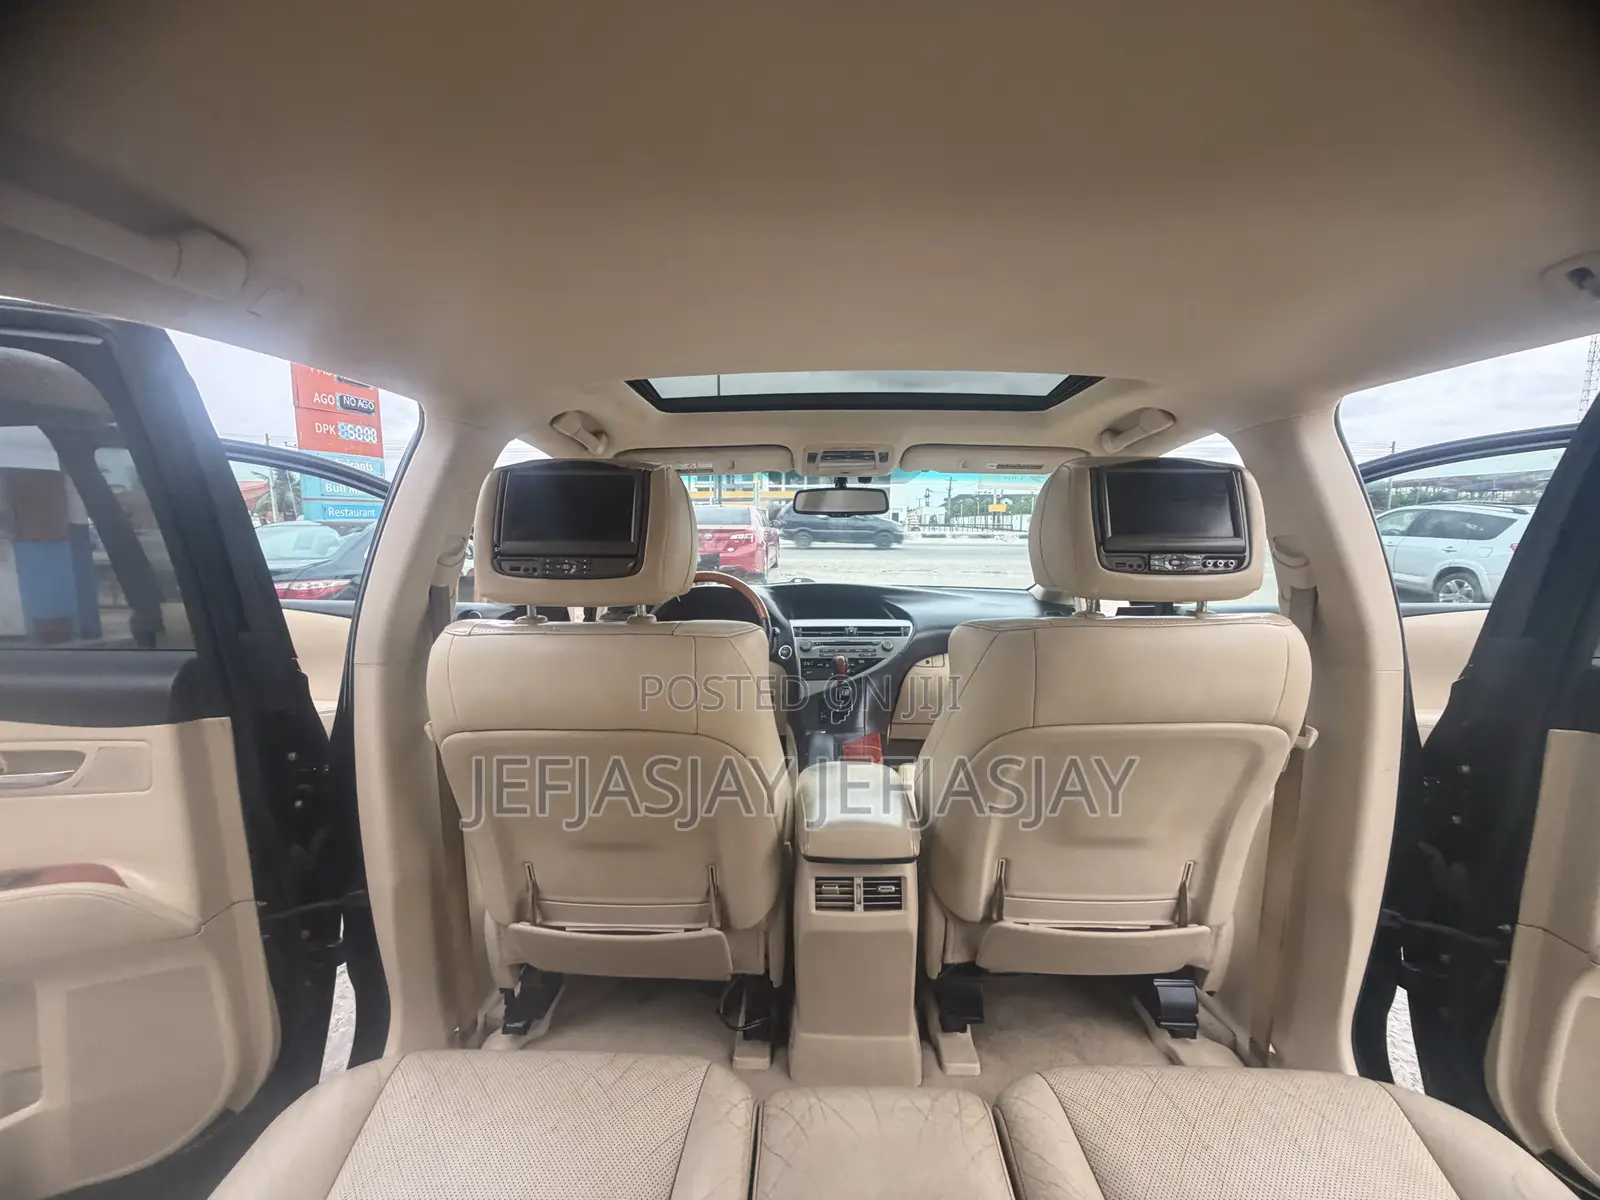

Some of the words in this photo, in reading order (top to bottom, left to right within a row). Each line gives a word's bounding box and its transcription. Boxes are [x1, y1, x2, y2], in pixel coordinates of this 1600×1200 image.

[313, 392, 335, 405] AGO
[343, 396, 356, 407] NO
[357, 399, 375, 410] AGO
[315, 422, 336, 435] DPK
[328, 507, 376, 517] Restaurant
